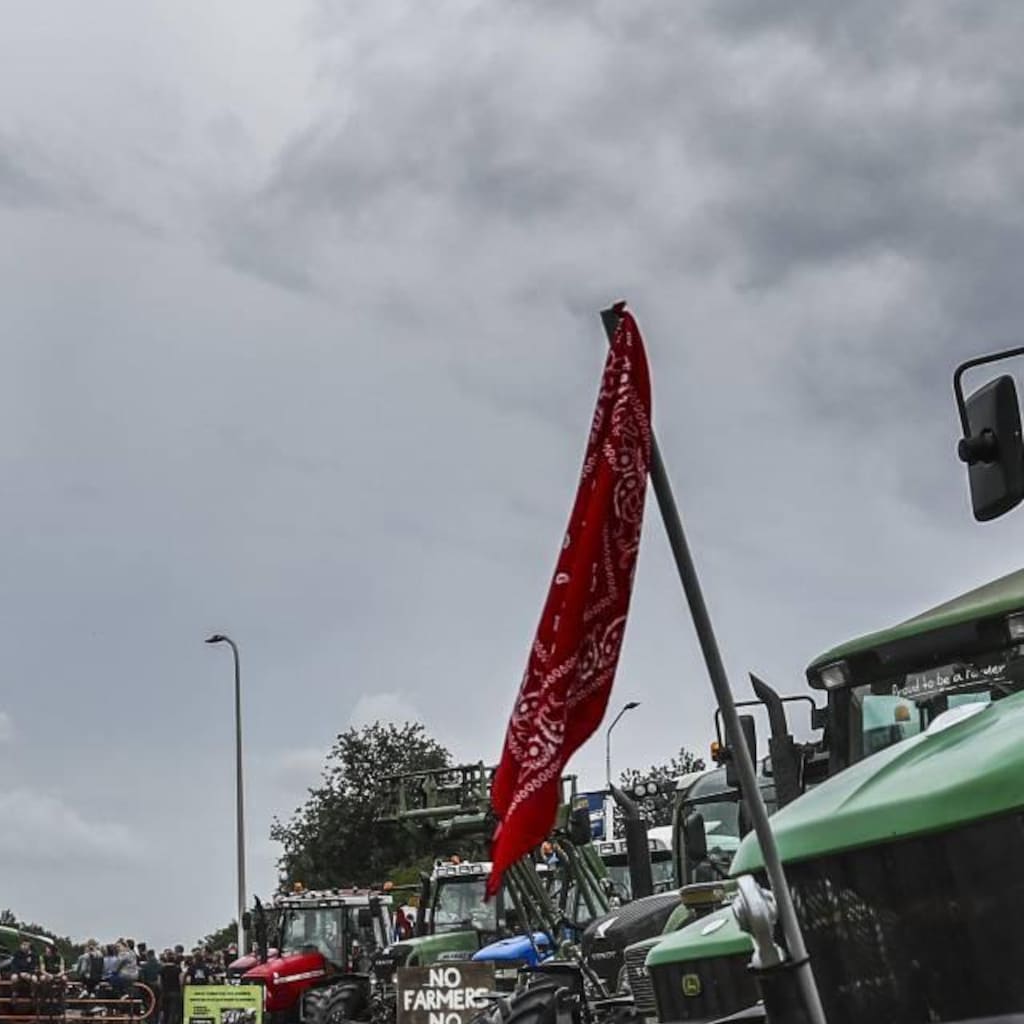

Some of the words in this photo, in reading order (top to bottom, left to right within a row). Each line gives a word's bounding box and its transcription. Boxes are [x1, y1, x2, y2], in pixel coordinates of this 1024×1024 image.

[922, 675, 934, 689] to
[936, 672, 951, 686] be
[953, 673, 964, 682] a
[429, 967, 461, 988] NO
